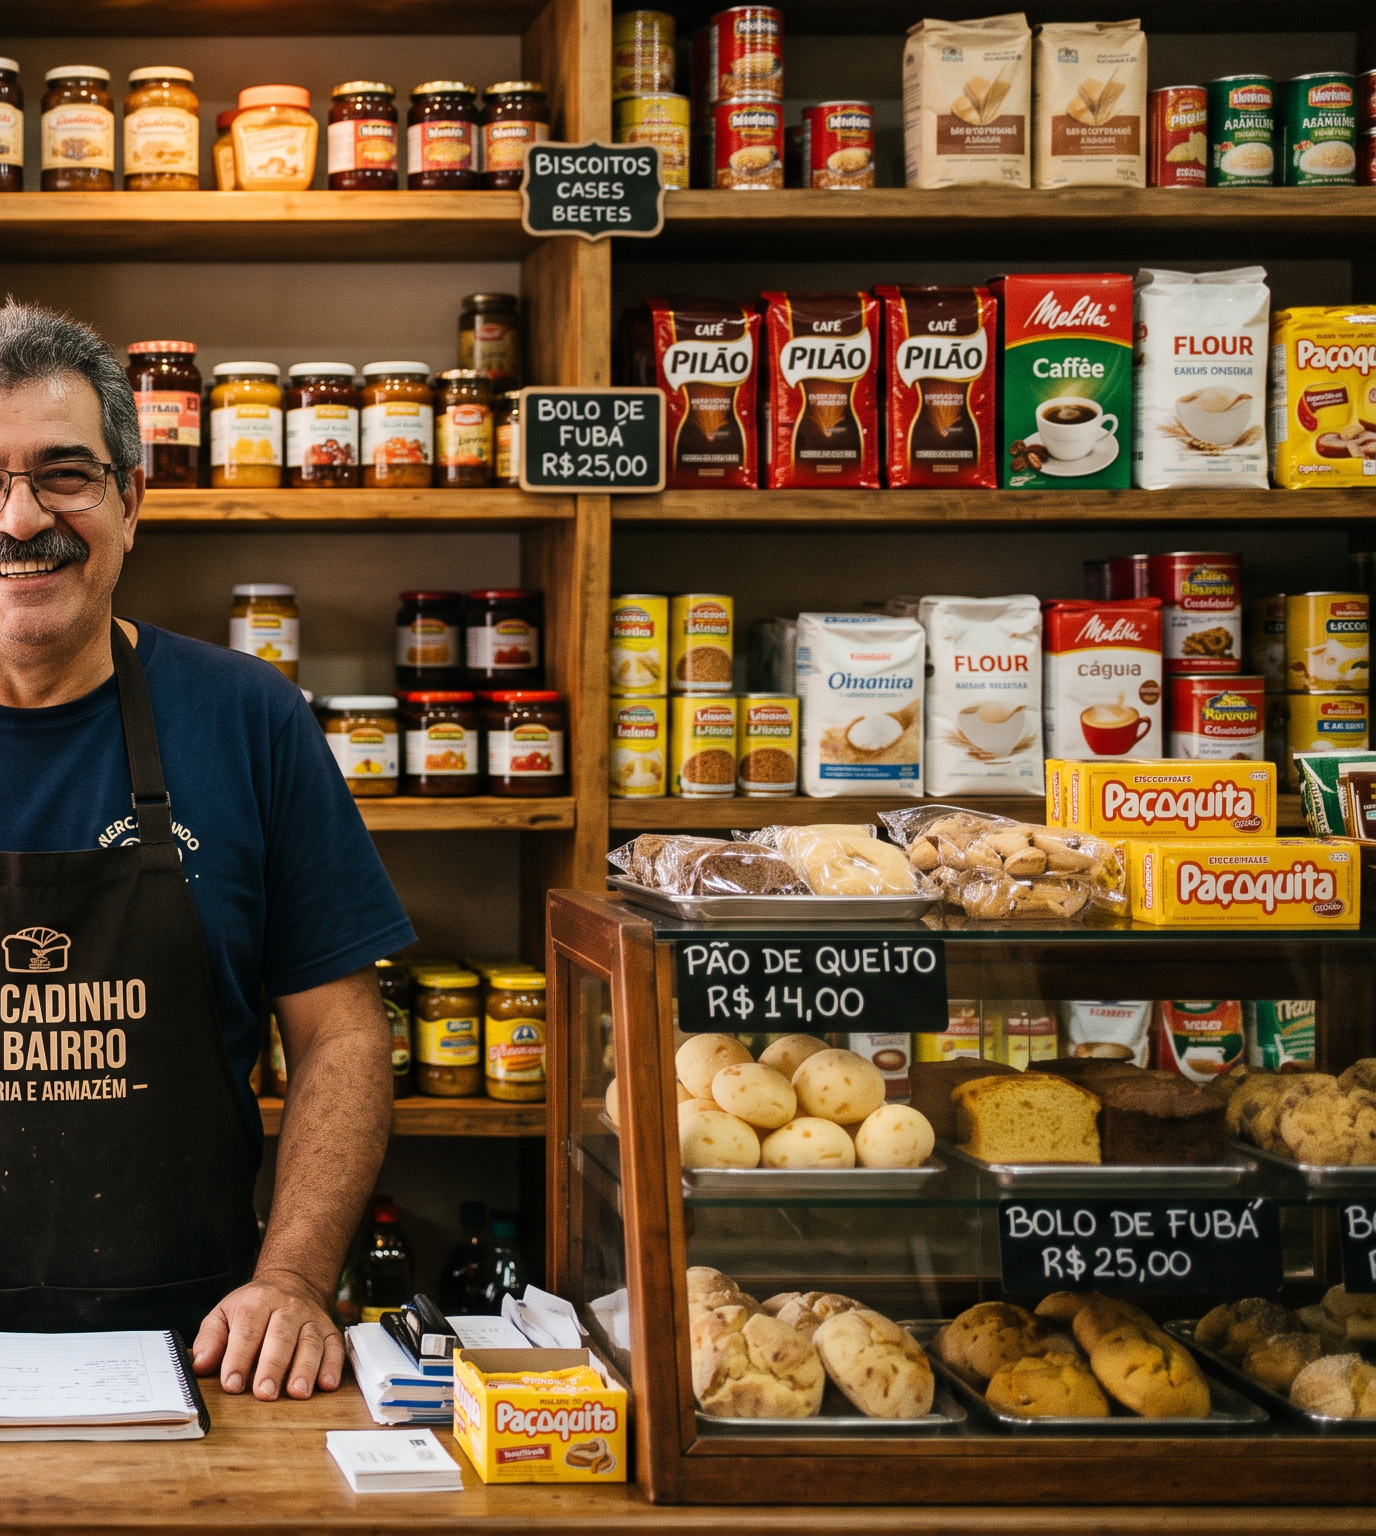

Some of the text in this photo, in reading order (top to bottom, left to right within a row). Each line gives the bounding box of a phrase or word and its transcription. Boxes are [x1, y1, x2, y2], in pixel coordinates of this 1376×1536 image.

[535, 153, 651, 176] BISCOITOS
[556, 181, 625, 200] CASES
[552, 205, 632, 223] BEETES
[1023, 290, 1110, 329] Melitta
[694, 321, 724, 337] CAFÉ
[812, 319, 842, 334] CAFÉ
[670, 344, 749, 375] PILÃO
[787, 342, 867, 372] PILÃO
[904, 342, 983, 372] PILÃO
[1174, 335, 1254, 356] FLOUR
[538, 399, 645, 422] BOLO DE
[559, 420, 627, 447] FUBÁ
[954, 655, 1029, 673] FLOUR
[1104, 783, 1252, 827] Paçoquita
[1180, 864, 1333, 911] Paçoquita
[683, 941, 936, 976] PÃO DE QUEIJO
[3, 1028, 127, 1071] BAIRRO
[27, 1081, 38, 1102] E
[42, 1075, 127, 1101] ARMAZÉM
[1005, 1198, 1264, 1238] BOLO DE FUBÁ
[1344, 1205, 1376, 1239] B
[497, 1402, 617, 1441] Paçoquita
